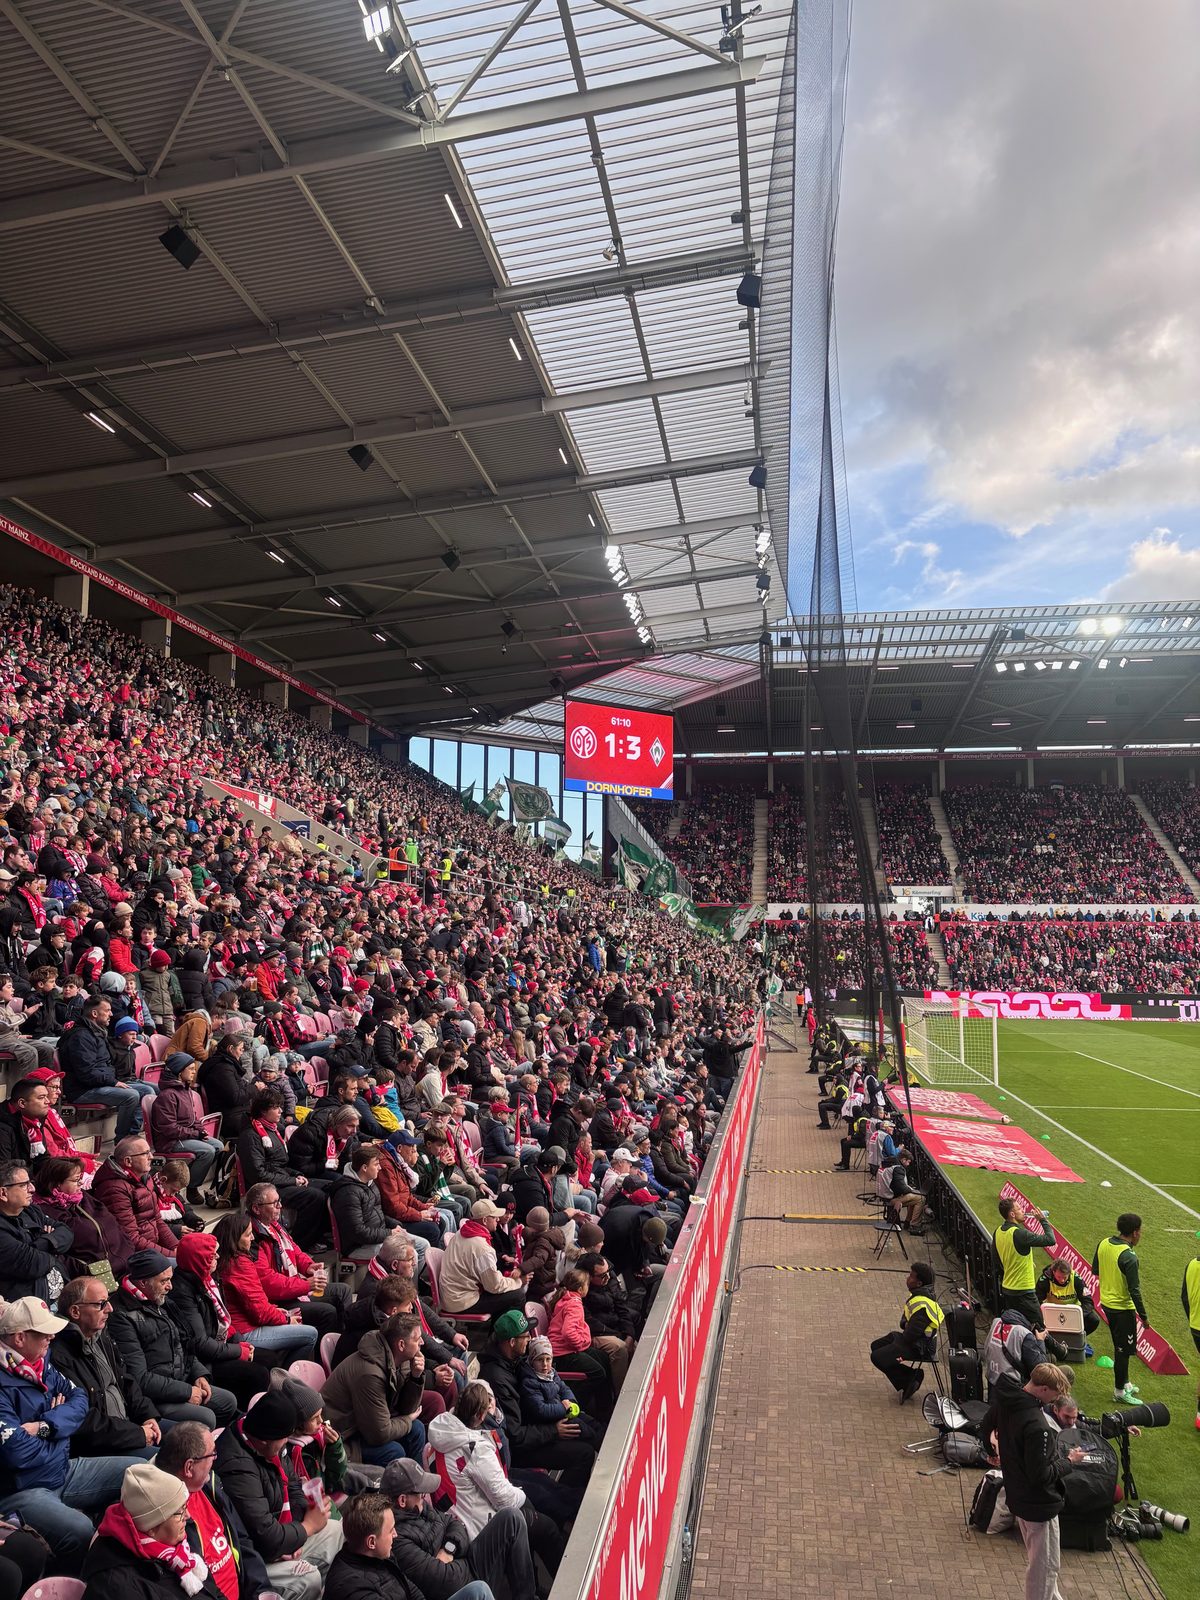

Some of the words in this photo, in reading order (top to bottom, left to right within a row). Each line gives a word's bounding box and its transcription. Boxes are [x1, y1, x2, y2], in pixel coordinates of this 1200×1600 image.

[70, 557, 98, 578] ROCKLAND
[99, 573, 114, 587] RADIO
[118, 583, 133, 597] ROCKT
[611, 717, 631, 727] 61:10
